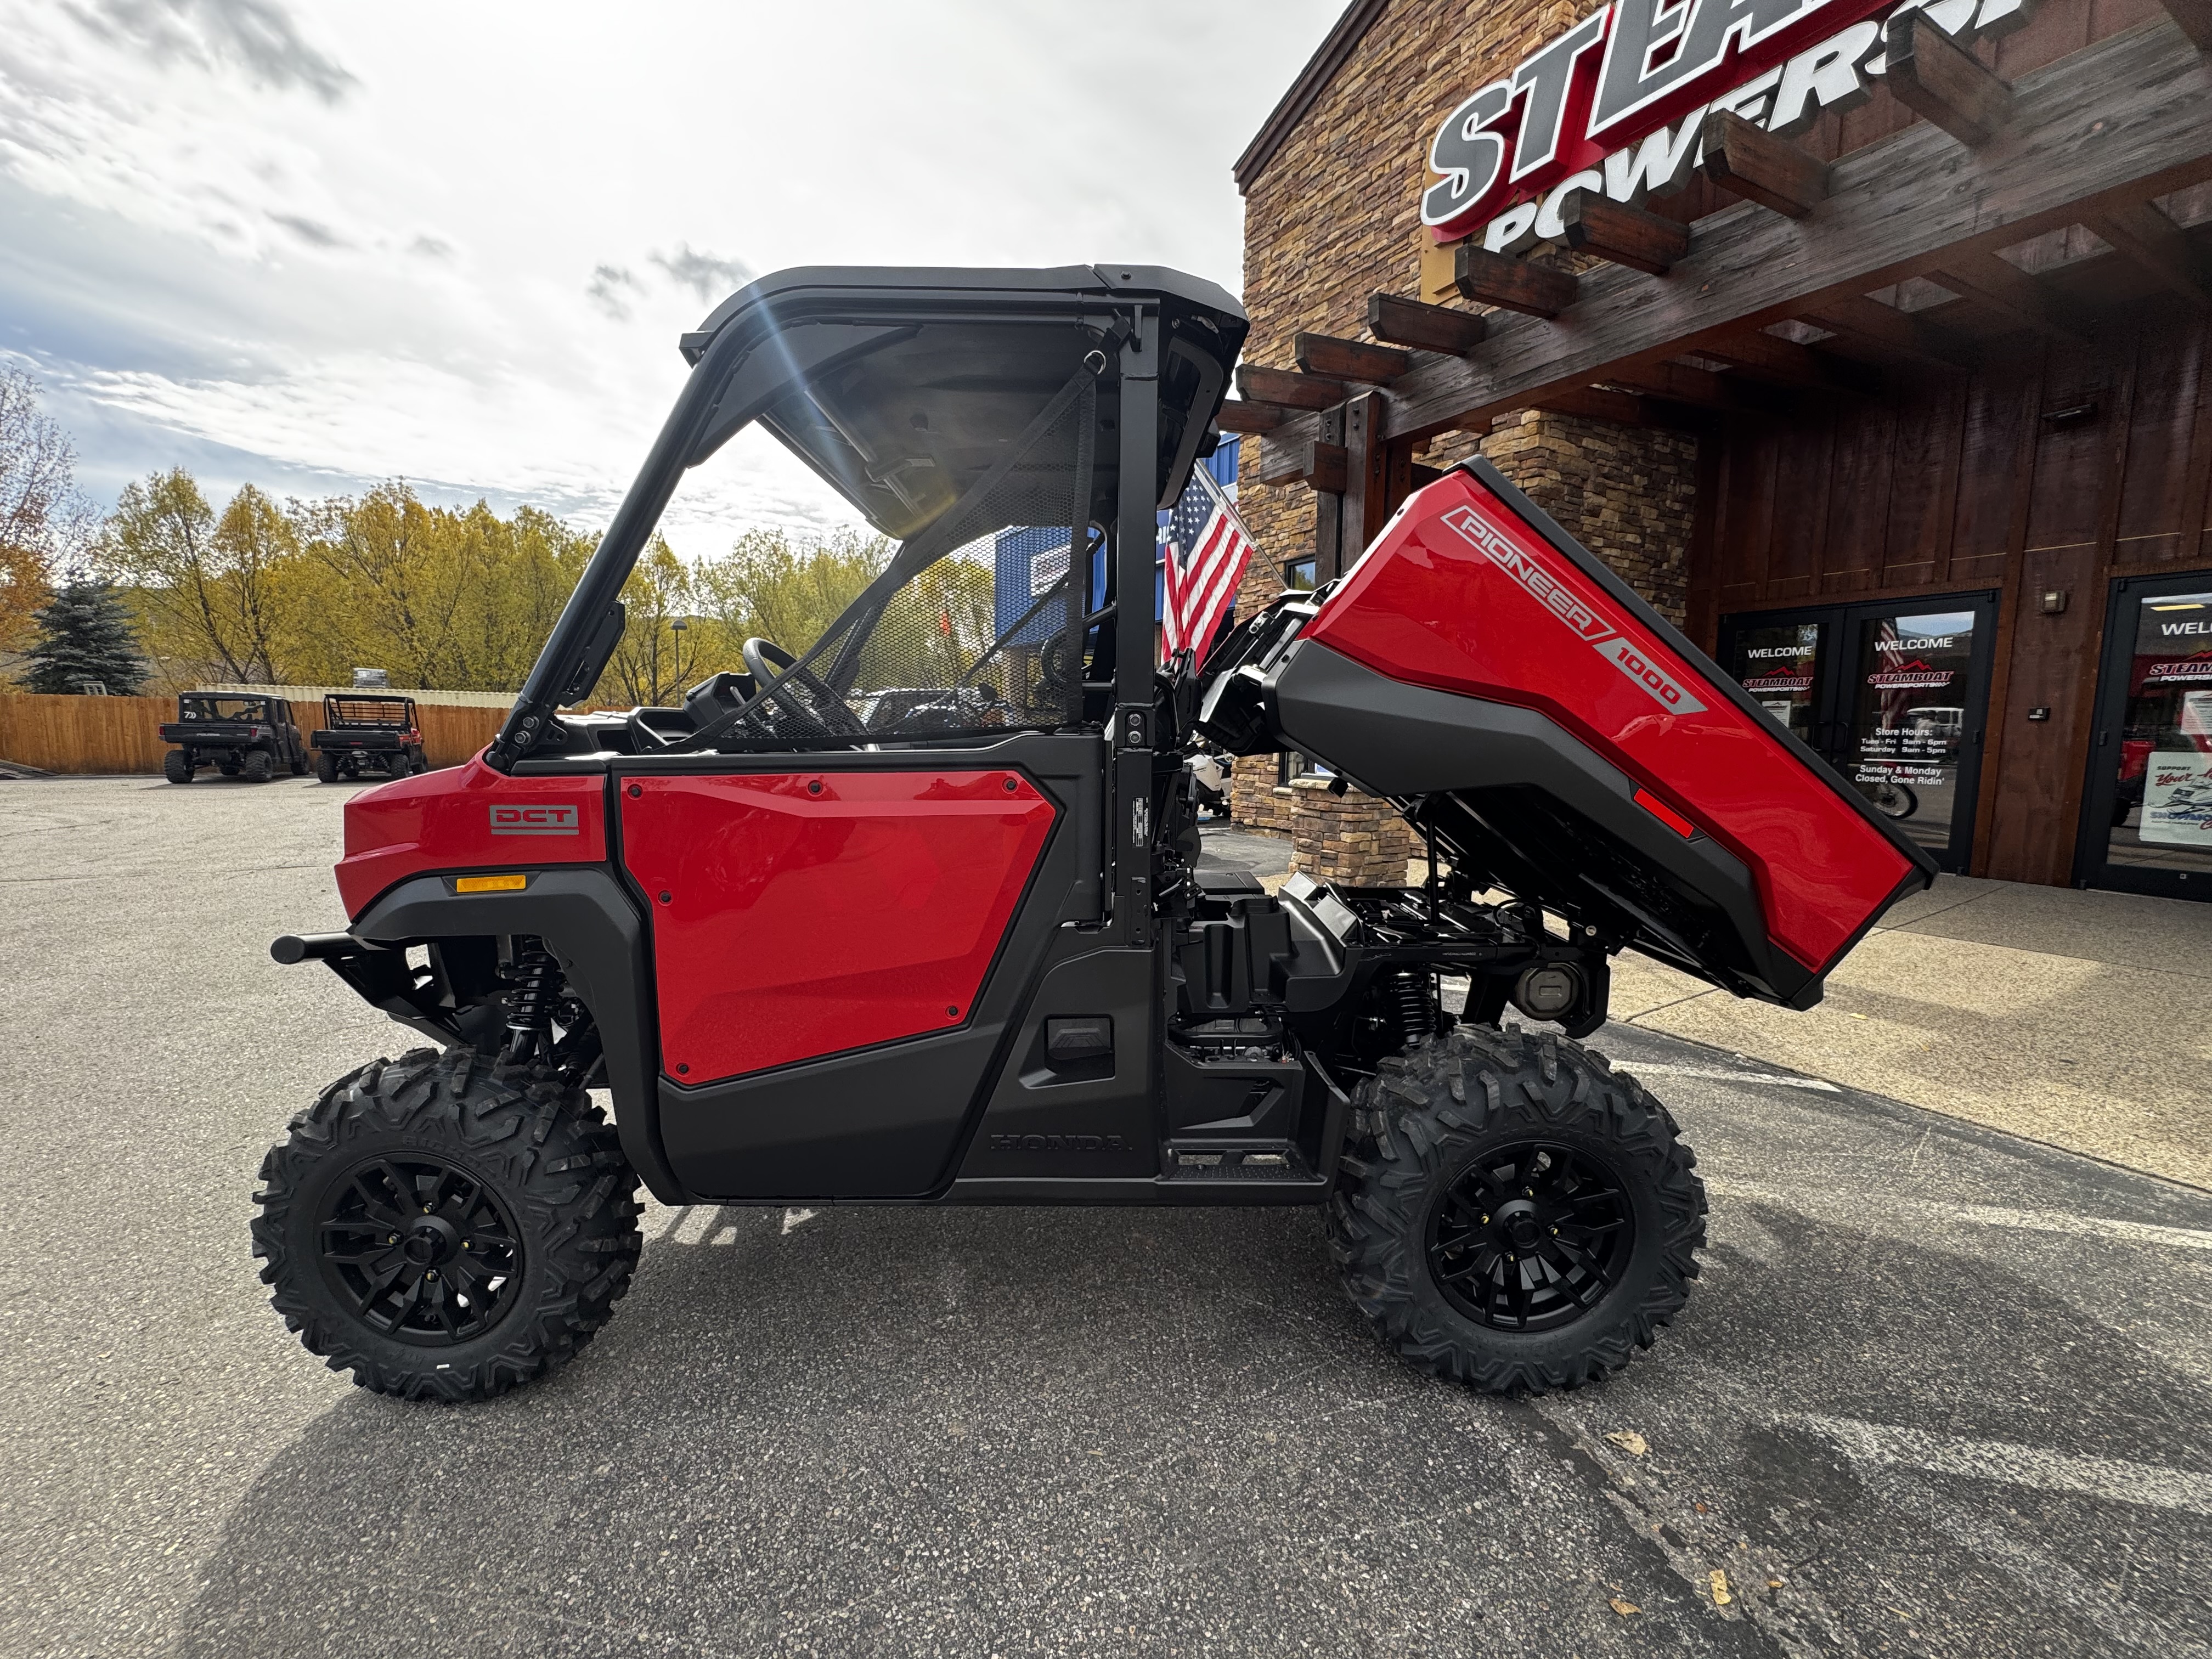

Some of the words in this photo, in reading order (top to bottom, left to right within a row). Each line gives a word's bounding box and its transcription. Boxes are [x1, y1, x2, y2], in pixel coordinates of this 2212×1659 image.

[1459, 515, 1593, 631] PIONEER
[1615, 646, 1681, 706] 1000
[2162, 622, 2212, 636] WEL
[1875, 637, 1954, 651] WELCOME
[1747, 646, 1813, 658] WELCOME
[1742, 676, 1814, 688] STEAMBOAT
[1867, 670, 1955, 684] STEAMBOAT
[1875, 727, 1899, 736] Store
[1901, 728, 1933, 736] Hours:
[1860, 765, 1893, 775] Sunday
[1904, 766, 1942, 777] Monday
[1855, 774, 1888, 784] Closed,
[1891, 775, 1915, 784] Gone
[1917, 776, 1945, 786] Ridin'
[2154, 772, 2194, 787] Your
[495, 809, 572, 822] DCT
[990, 1133, 1133, 1151] HONDA
